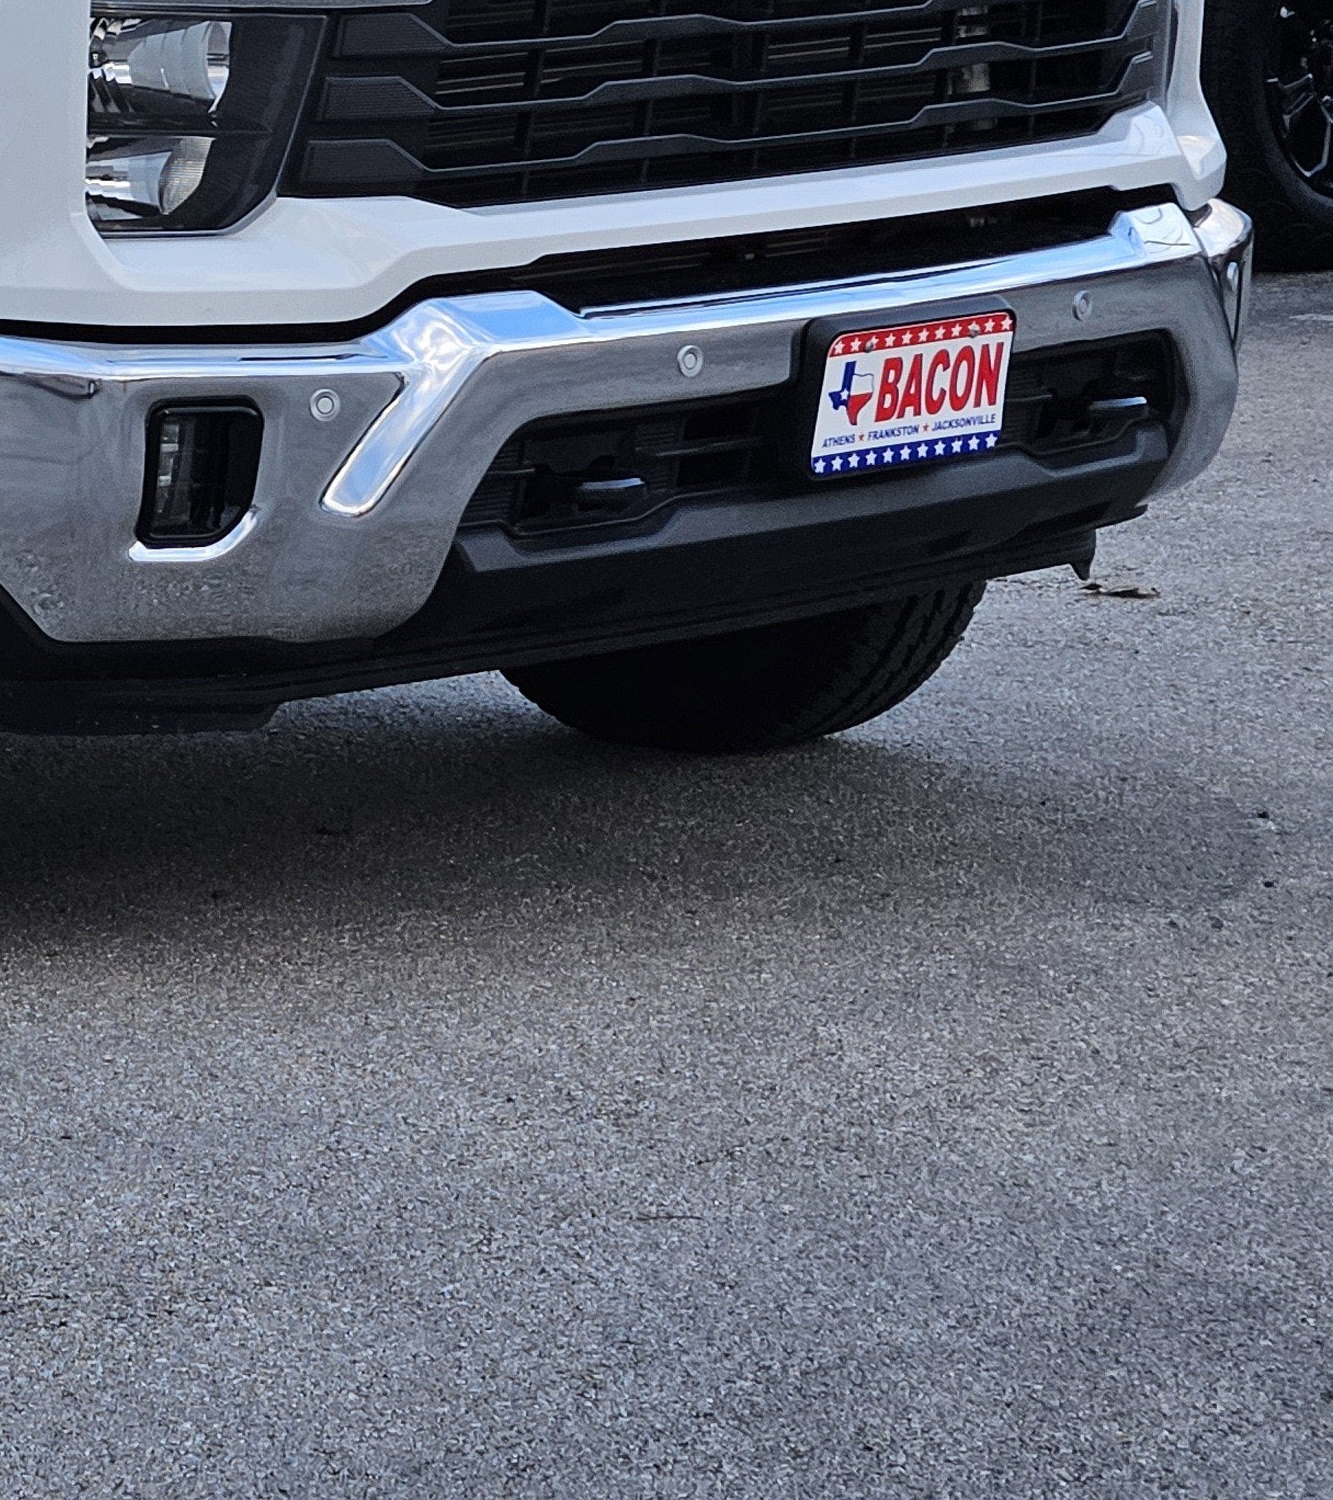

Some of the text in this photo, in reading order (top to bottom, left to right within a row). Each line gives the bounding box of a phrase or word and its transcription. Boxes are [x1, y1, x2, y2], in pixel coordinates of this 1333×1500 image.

[874, 342, 1005, 423] BACON
[821, 414, 997, 449] ATHENS FRANKSTON JACKSONVILLE
